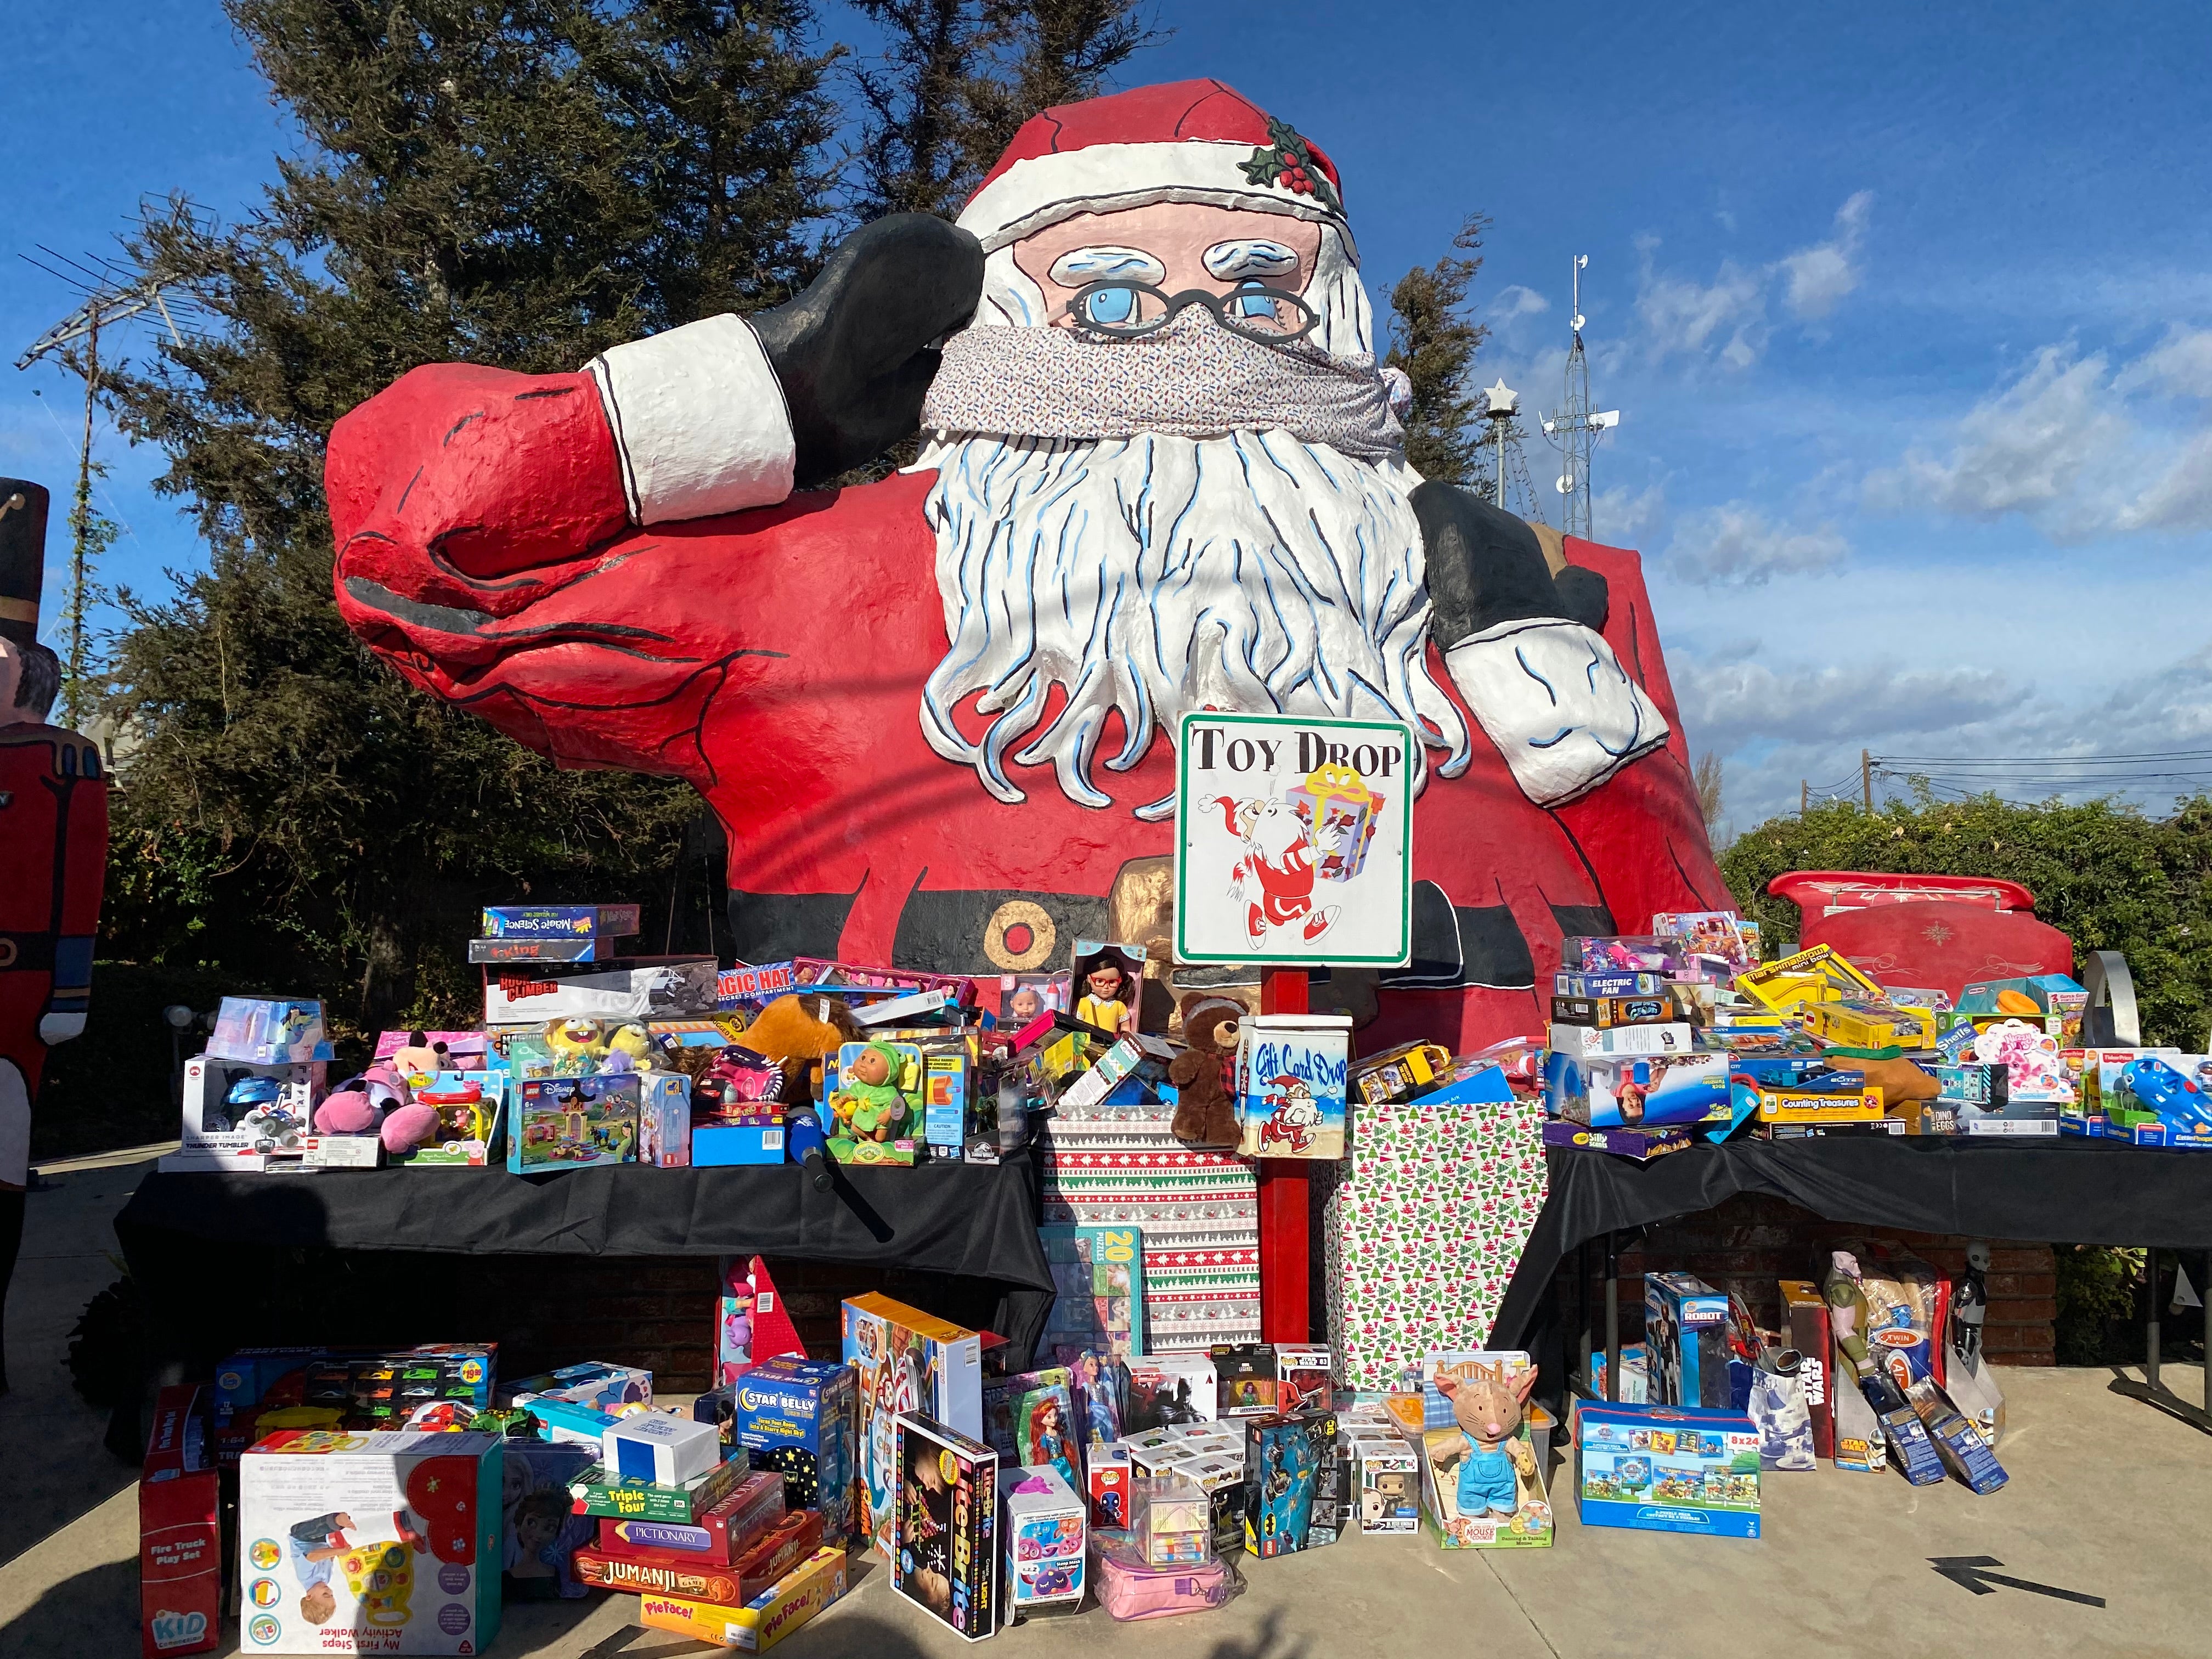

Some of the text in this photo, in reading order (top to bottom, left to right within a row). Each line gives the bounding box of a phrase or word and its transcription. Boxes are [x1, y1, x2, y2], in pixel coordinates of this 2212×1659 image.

[1192, 726, 1401, 777] TOY DROP
[1792, 959, 1809, 971] mini
[499, 972, 531, 990] ROCK
[718, 967, 791, 997] AGIC HAT
[1592, 978, 1632, 989] ELECTRIC
[507, 981, 558, 1002] CLIMBER
[744, 986, 794, 998] COMPARTMENT
[1601, 986, 1620, 995] FAN
[1936, 1026, 1971, 1051] Shells
[1256, 1042, 1347, 1087] Gift Card Drop
[526, 1082, 575, 1097] LEGO Disney
[1782, 1098, 1859, 1110] Counting Treasures
[1935, 1110, 1952, 1121] DINO
[1936, 1120, 1954, 1131] EGGS
[1588, 1132, 1607, 1142] Silly
[1096, 1232, 1105, 1261] PUZZLES
[1104, 1231, 1134, 1262] 20
[1684, 1312, 1722, 1321] ROBOT
[1811, 1359, 1825, 1406] WARS
[747, 1391, 816, 1412] STAR BELLY
[1326, 1420, 1335, 1435] DC
[1731, 1436, 1759, 1446] 8x24
[1841, 1443, 1867, 1452] WARS
[1843, 1438, 1866, 1447] STAR
[608, 1488, 645, 1503] Triple
[618, 1502, 646, 1514] Four
[635, 1527, 698, 1543] PICTIONARY
[1466, 1528, 1495, 1536] MOUSE
[150, 1538, 206, 1555] Fire Truck
[156, 1551, 201, 1565] Play Set
[768, 1538, 800, 1576] JUMANJI
[604, 1561, 676, 1592] JUMANJI
[644, 1601, 693, 1620] PieFace!
[154, 1614, 204, 1640] KID
[319, 1626, 403, 1639] Activity Walker
[322, 1638, 399, 1650] My First Steps
